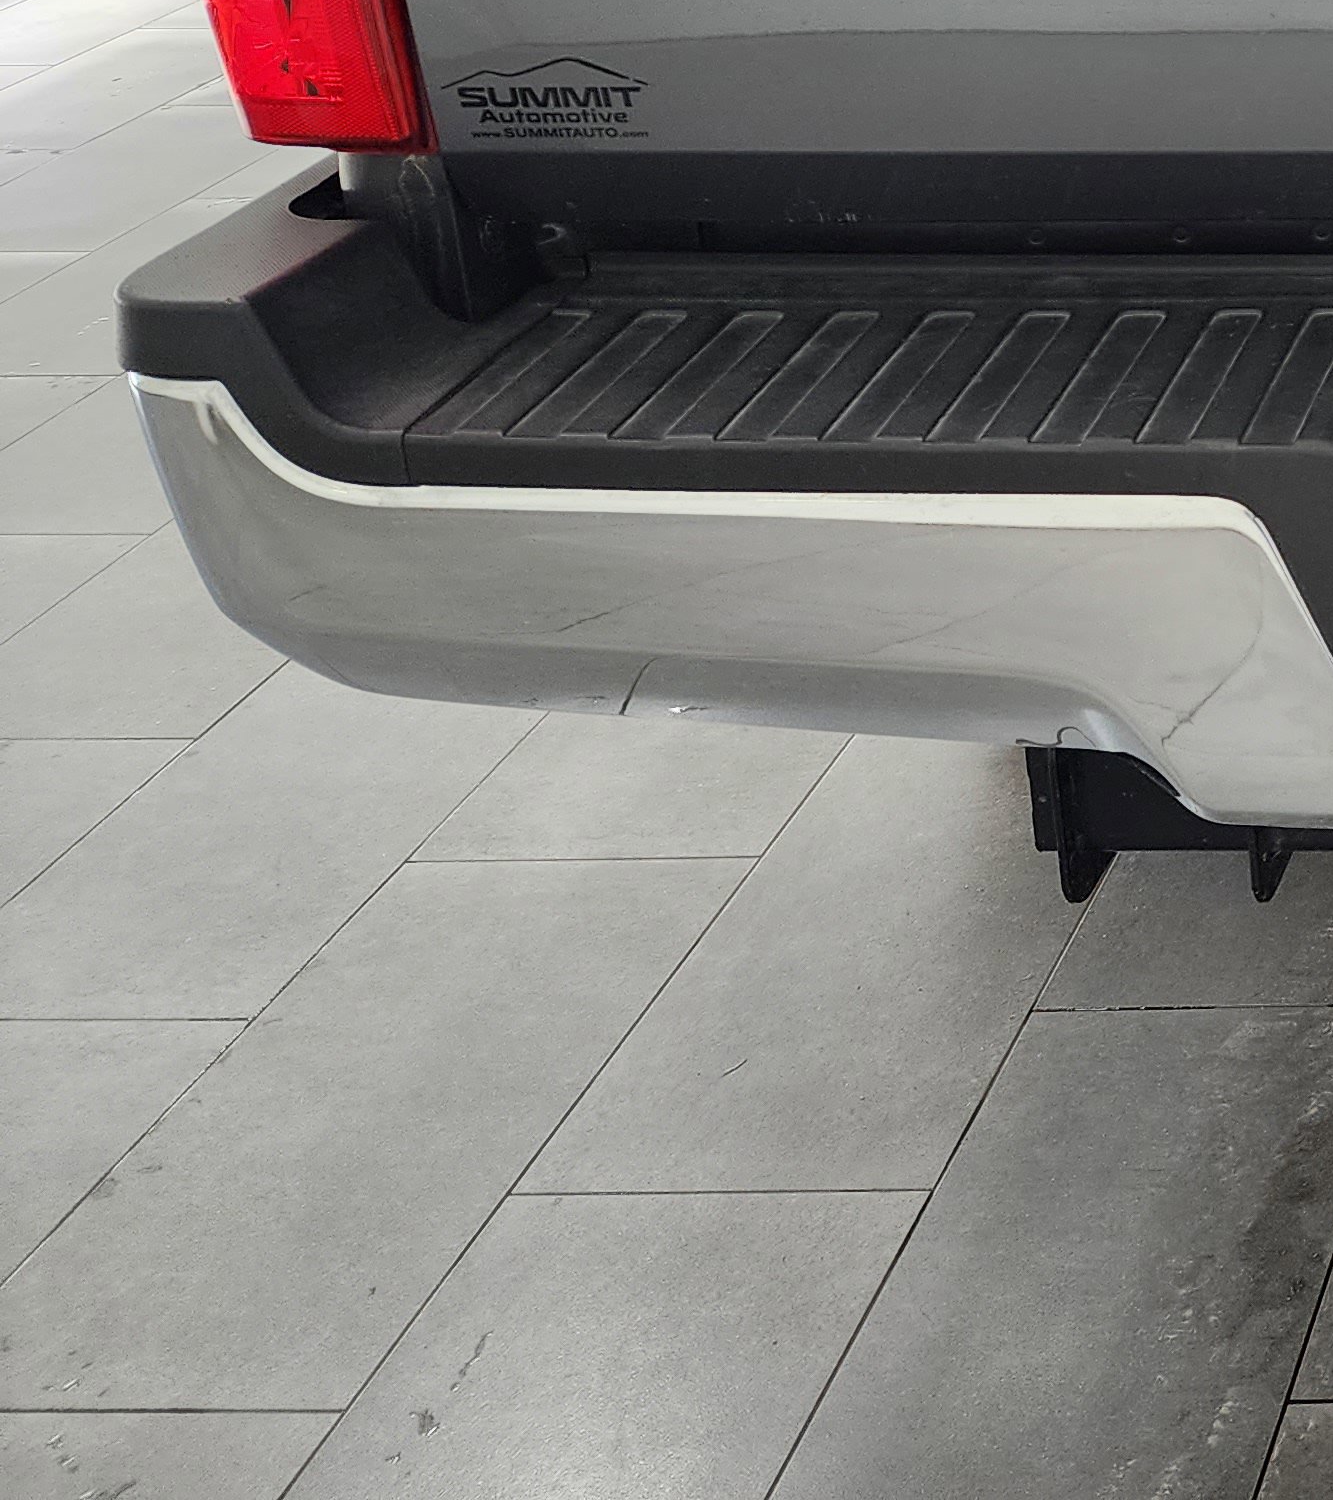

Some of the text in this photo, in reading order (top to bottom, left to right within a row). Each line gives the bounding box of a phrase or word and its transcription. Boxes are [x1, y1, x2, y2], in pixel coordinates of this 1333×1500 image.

[457, 87, 641, 108] SUMMIT
[479, 108, 629, 123] Automotive
[471, 126, 649, 139] www.SUMMITAUTO.com
